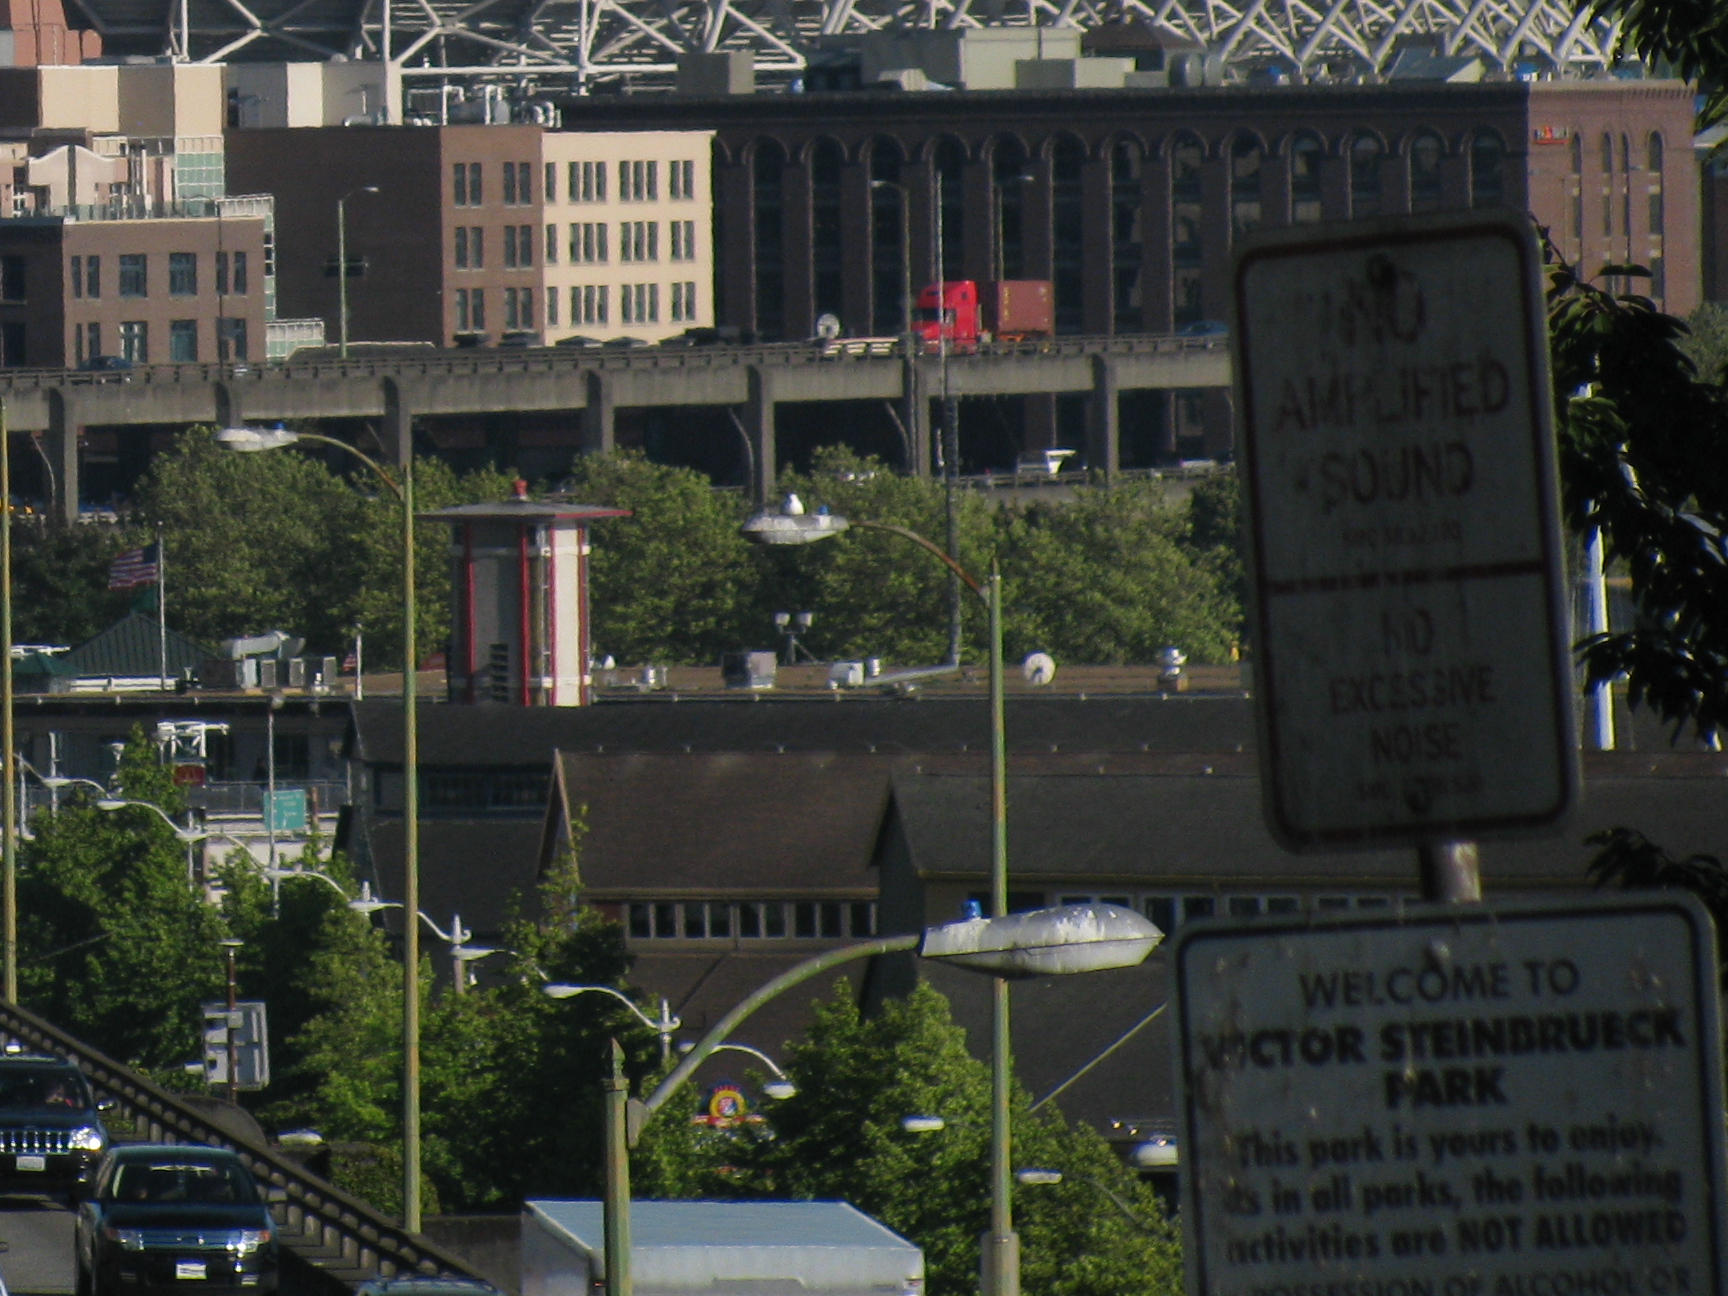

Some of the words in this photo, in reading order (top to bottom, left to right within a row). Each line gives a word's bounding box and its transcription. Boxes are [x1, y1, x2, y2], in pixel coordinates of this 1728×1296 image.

[1272, 359, 1509, 431] AMPLIFIED
[1320, 441, 1474, 509] SOUND
[1381, 607, 1433, 658] NO
[1329, 664, 1496, 715] EXCESSIVE
[1371, 722, 1463, 766] NOISE
[1299, 962, 1510, 1007] WELCOME
[1522, 957, 1580, 997] TO
[1379, 1008, 1688, 1063] STEINBRUECK
[1383, 1066, 1509, 1110] PARK
[1234, 1128, 1298, 1168] This
[1308, 1126, 1383, 1170] park
[1391, 1123, 1418, 1161] is
[1429, 1128, 1517, 1167] yours
[1525, 1123, 1560, 1154] to
[1271, 1177, 1301, 1214] in
[1312, 1174, 1351, 1214] all
[1472, 1167, 1522, 1204] the
[1534, 1160, 1682, 1204] following
[1226, 1223, 1379, 1266] activities
[1391, 1227, 1446, 1257] are
[1457, 1217, 1522, 1252] NOT
[1535, 1209, 1687, 1250] ALLOWED
[1495, 1268, 1635, 1296] ALCOHOL
